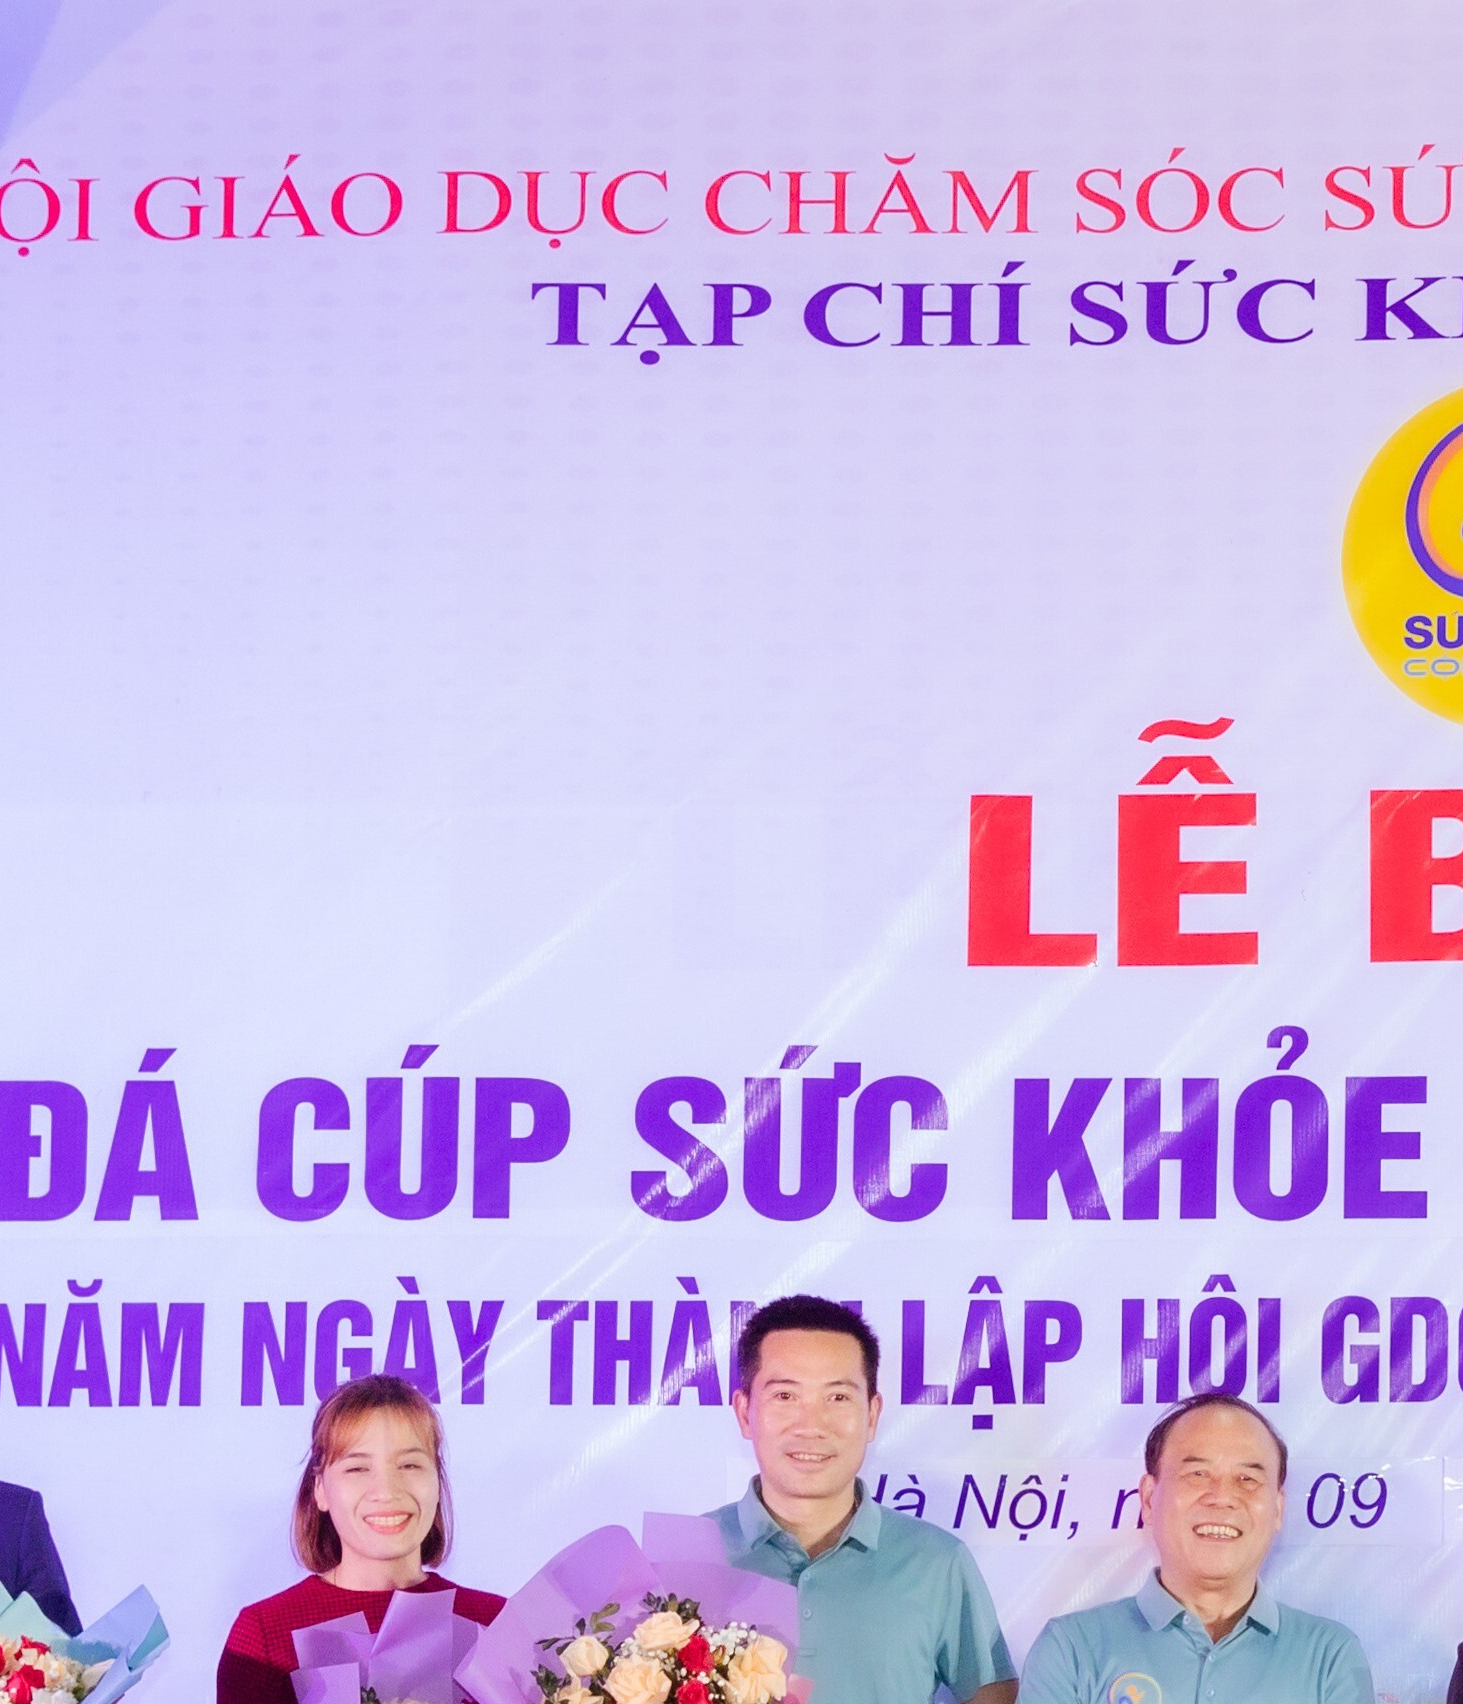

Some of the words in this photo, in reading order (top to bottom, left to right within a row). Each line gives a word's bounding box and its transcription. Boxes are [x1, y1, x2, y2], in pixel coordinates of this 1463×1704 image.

[134, 154, 404, 241] GIÁO
[437, 169, 669, 249] DỤC
[704, 152, 1039, 235] CHĂM
[1076, 147, 1285, 234] SÓC
[531, 281, 773, 366] TẠP
[803, 261, 1031, 348] CHÍ
[1069, 259, 1316, 347] SỨC
[967, 716, 1259, 967] LỄ
[256, 1044, 572, 1222] CÚP
[630, 1044, 949, 1223] SỨC
[1011, 1025, 1429, 1222] KHỎE
[241, 1275, 505, 1407] NGÀY
[537, 1276, 863, 1406] THÀ
[900, 1275, 1083, 1431] LẬP
[953, 1473, 1080, 1544] Nội,
[1305, 1472, 1388, 1530] 09
